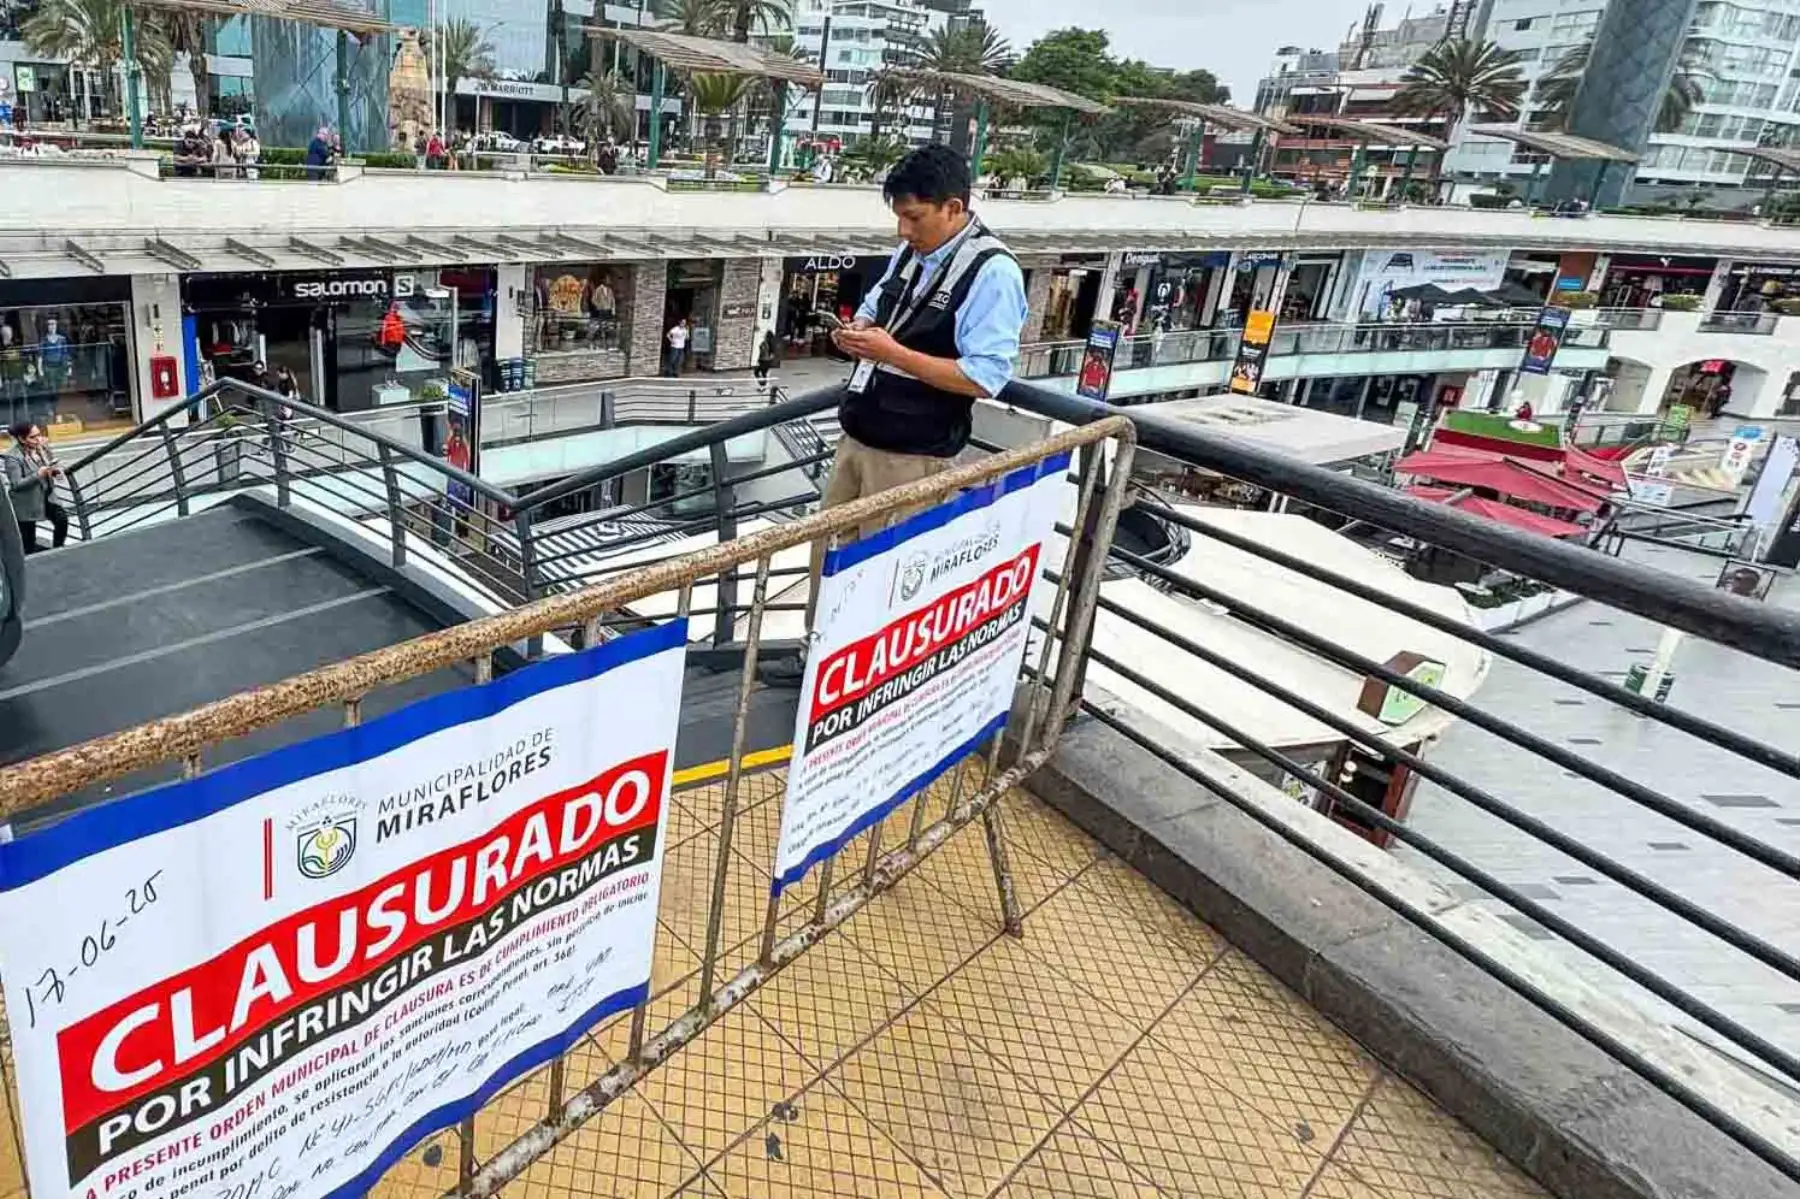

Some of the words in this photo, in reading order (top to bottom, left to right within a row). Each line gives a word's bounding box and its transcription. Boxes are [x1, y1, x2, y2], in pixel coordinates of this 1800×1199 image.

[295, 280, 387, 297] salomon
[804, 255, 856, 270] ALDO
[819, 556, 1031, 705] CLAUSURADO
[930, 537, 998, 584] MIRAFLORES
[812, 706, 853, 745] POR
[856, 656, 936, 723] INFRINGIR
[938, 643, 965, 670] LAS
[966, 603, 1021, 650] NORMAS
[376, 745, 553, 844] MIRAFLORES
[378, 740, 526, 813] MUNICIPALIDAD
[531, 728, 554, 746] DE
[91, 769, 651, 1092] CLAUSURADO
[98, 1076, 212, 1155] POR
[225, 945, 433, 1093] INFRINGIR
[443, 906, 504, 963] LAS
[511, 835, 640, 923] NORMAS
[104, 1132, 202, 1192] PRESENTE
[209, 1092, 266, 1140] ORDEN
[271, 1039, 360, 1099] MUNICIPAL
[364, 1027, 380, 1047] DE
[384, 979, 453, 1030] CLAUSURA
[459, 970, 475, 987] ES
[479, 958, 493, 980] DE
[495, 908, 579, 964] CUMPLIMIENTO
[581, 872, 649, 916] OBLIGATORIO
[145, 1176, 165, 1191] de
[172, 1106, 288, 1179] incumplimiento,
[294, 1089, 310, 1105] se
[379, 1036, 395, 1052] las
[399, 1000, 454, 1037] sanciones
[547, 935, 562, 950] sin
[603, 904, 615, 917] de
[169, 1171, 215, 1199] penal
[220, 1157, 245, 1180] por
[248, 1125, 288, 1159] delito
[291, 1109, 307, 1128] de
[310, 1067, 380, 1114] resistencia
[382, 1060, 389, 1069] a
[391, 1049, 402, 1063] la
[405, 1013, 460, 1051] autoridad
